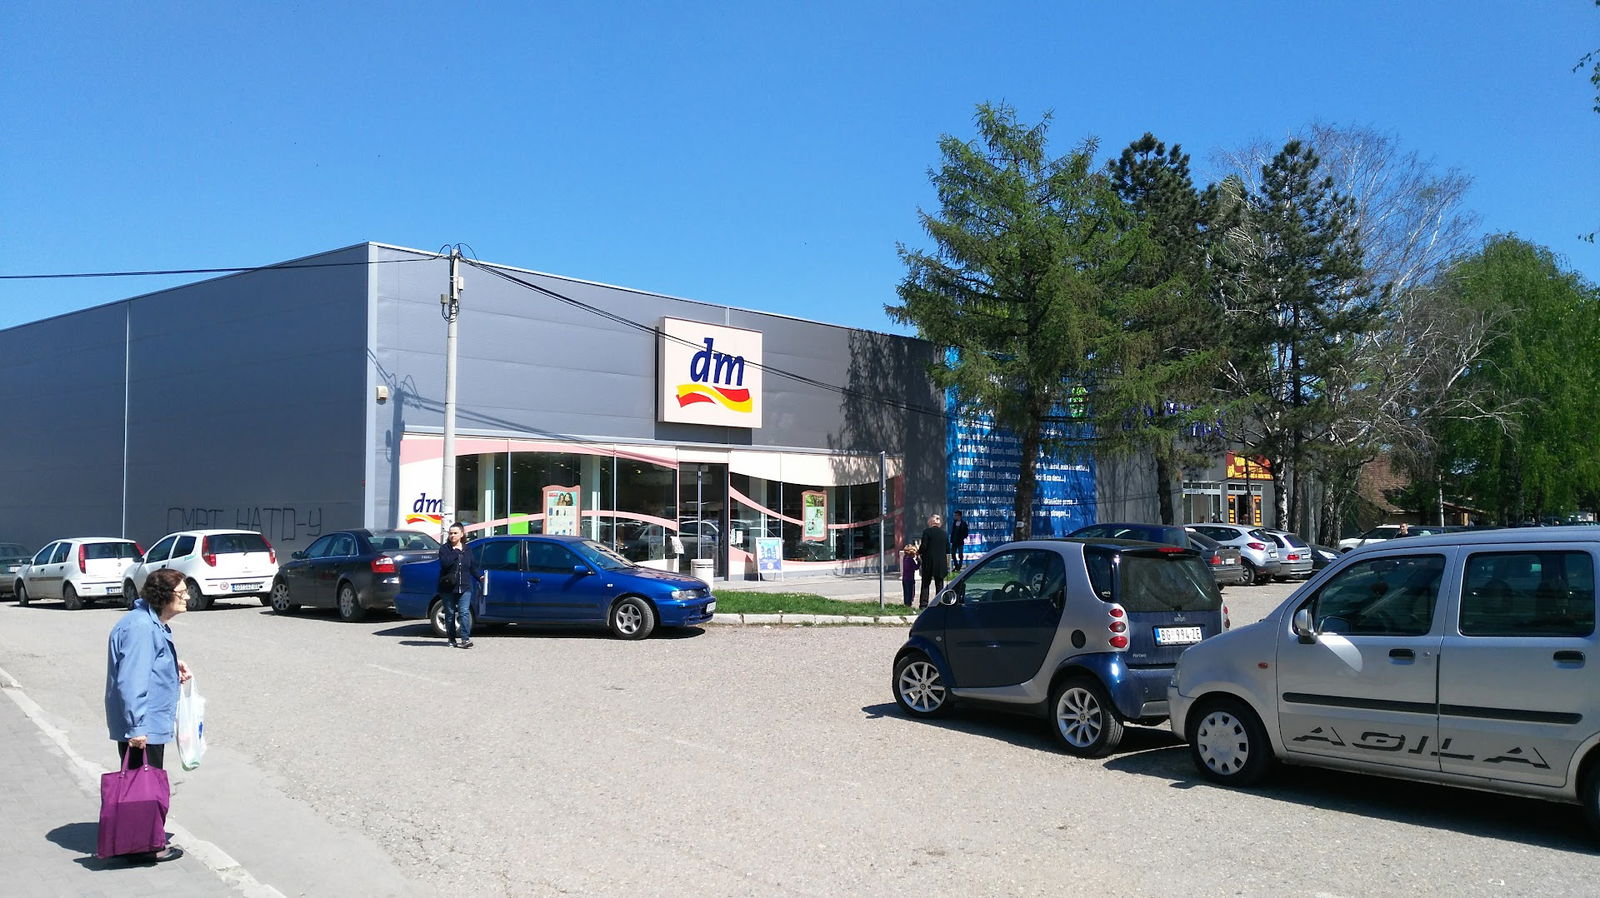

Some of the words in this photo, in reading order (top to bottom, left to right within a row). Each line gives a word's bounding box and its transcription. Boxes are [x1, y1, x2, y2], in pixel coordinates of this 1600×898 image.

[690, 337, 745, 387] dm
[413, 492, 443, 513] dm
[1160, 629, 1171, 641] BG
[1292, 726, 1551, 770] AGILA
